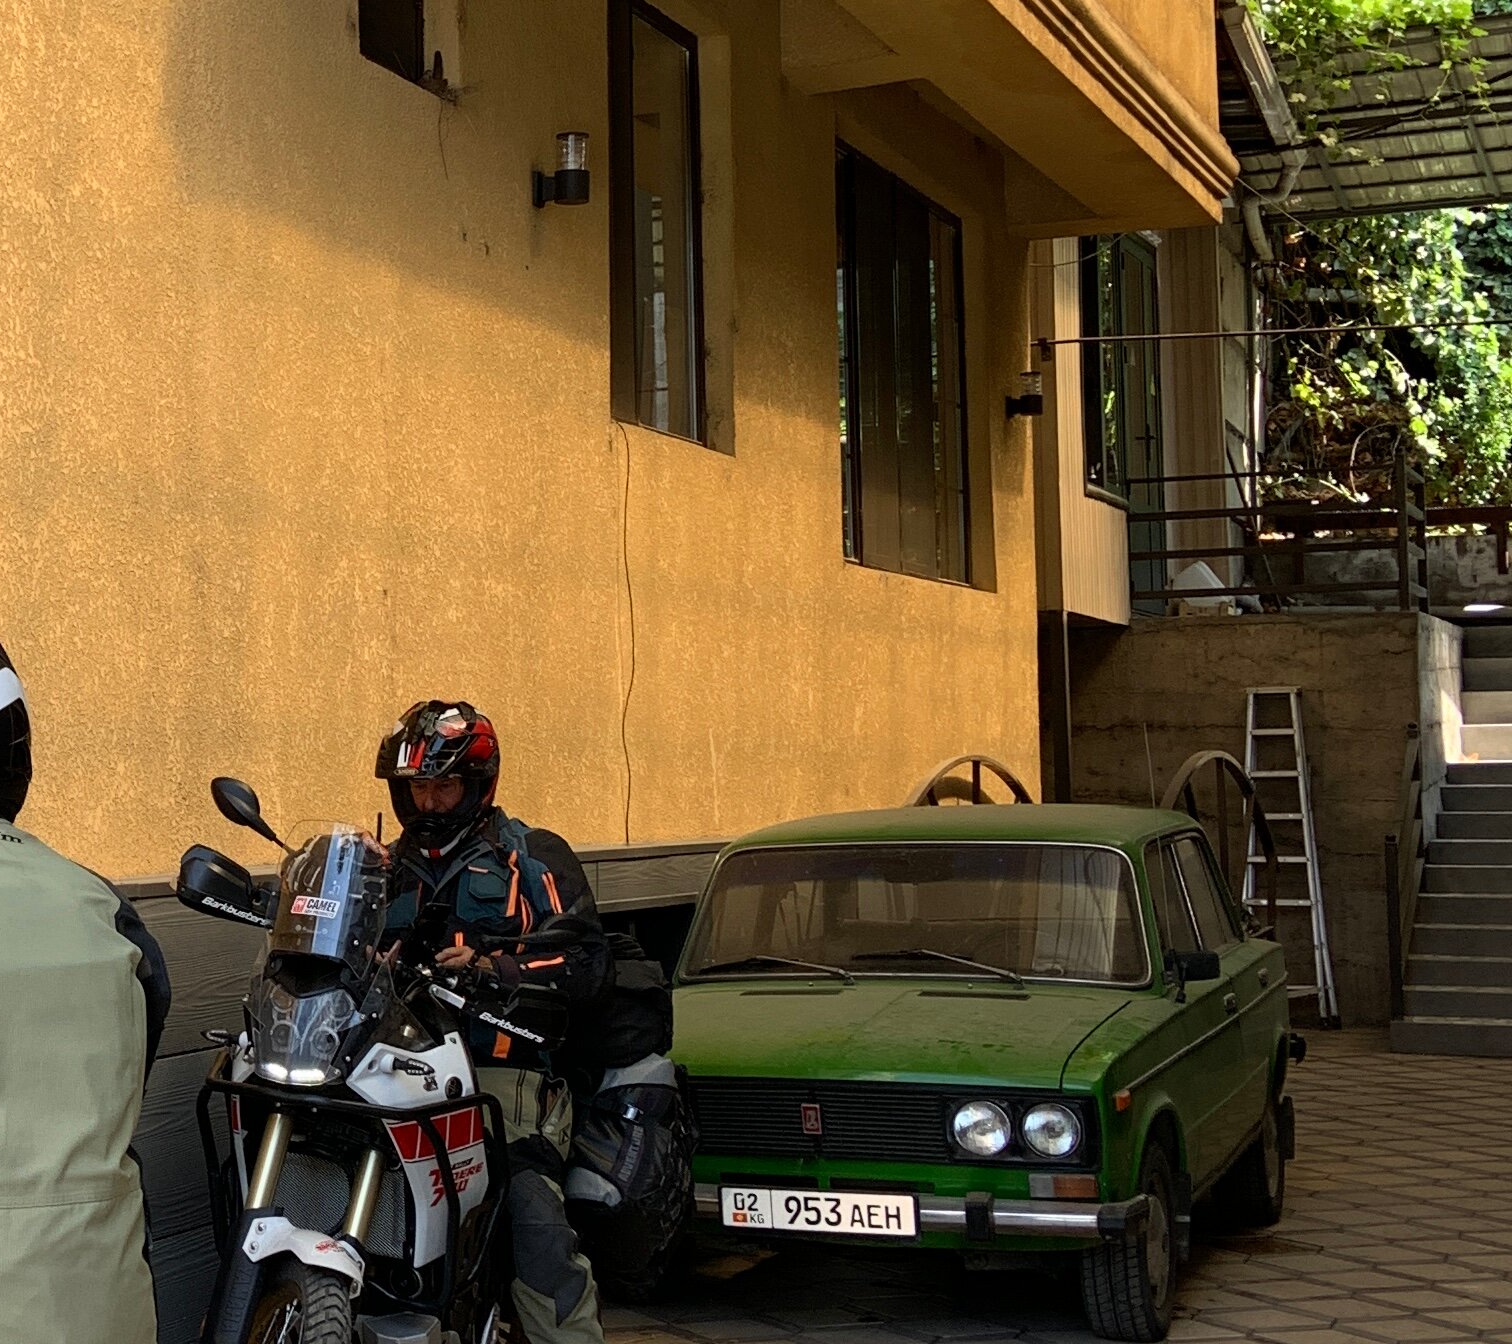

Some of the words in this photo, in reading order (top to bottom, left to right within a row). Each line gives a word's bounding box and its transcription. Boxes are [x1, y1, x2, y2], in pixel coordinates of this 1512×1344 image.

[306, 898, 337, 912] CAMEL
[479, 1012, 545, 1043] Barkbusters
[733, 1192, 759, 1212] 02
[784, 1195, 842, 1226] 953
[850, 1204, 902, 1229] AEH
[749, 1212, 765, 1224] KG
